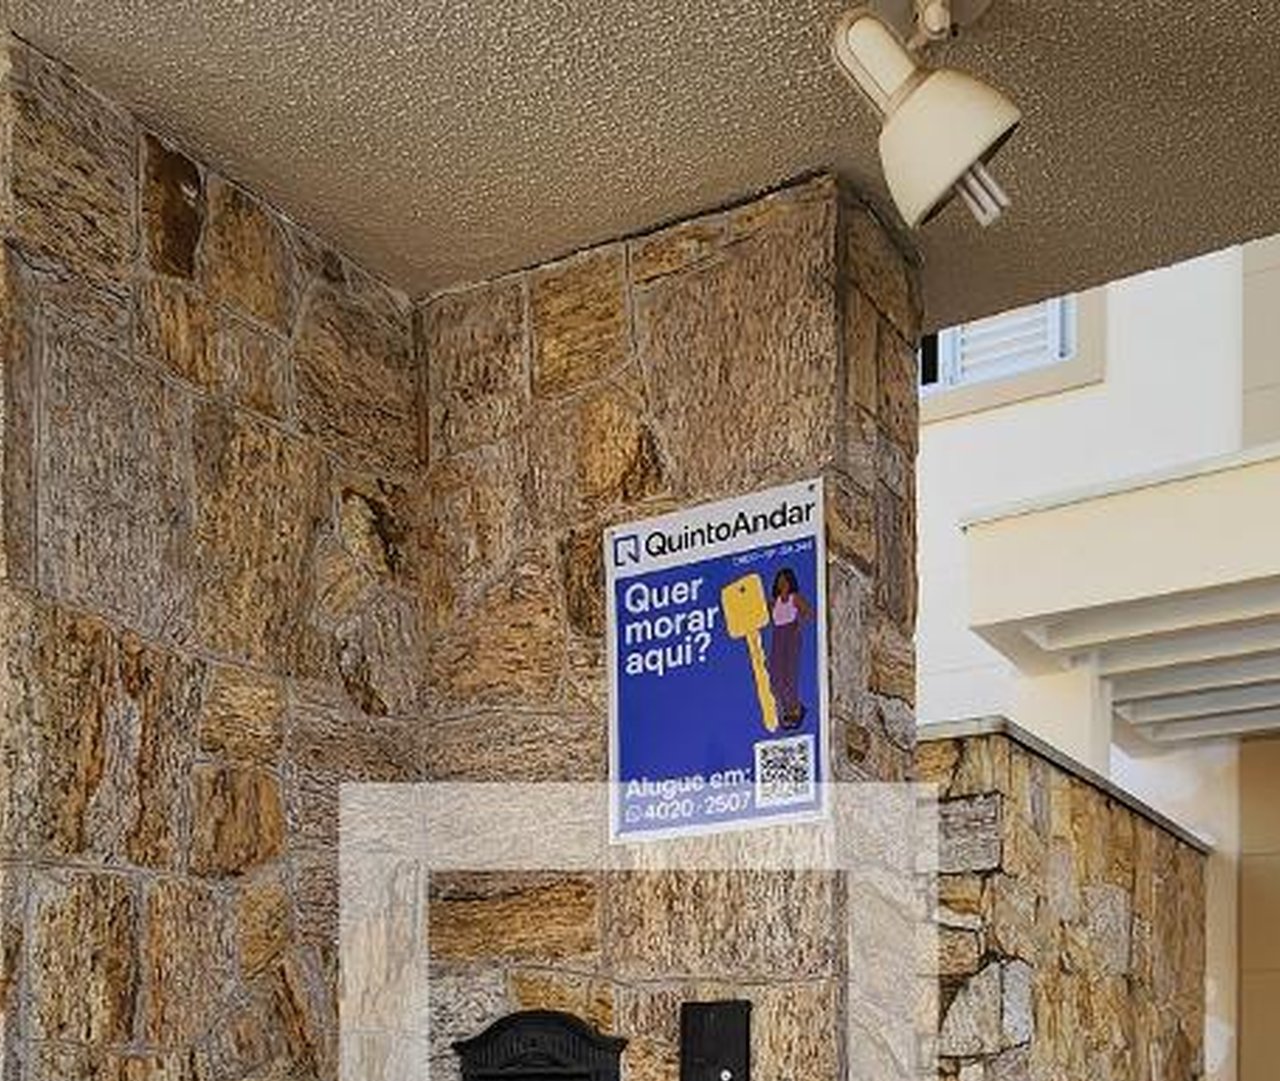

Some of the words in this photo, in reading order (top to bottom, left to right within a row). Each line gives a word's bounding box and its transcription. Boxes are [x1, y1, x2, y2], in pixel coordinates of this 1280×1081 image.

[645, 501, 816, 557] QuintoAndar
[624, 576, 704, 614] Quer
[624, 605, 720, 646] morar
[624, 633, 712, 677] aqui?
[625, 776, 705, 801] Alugue
[709, 767, 752, 790] em:
